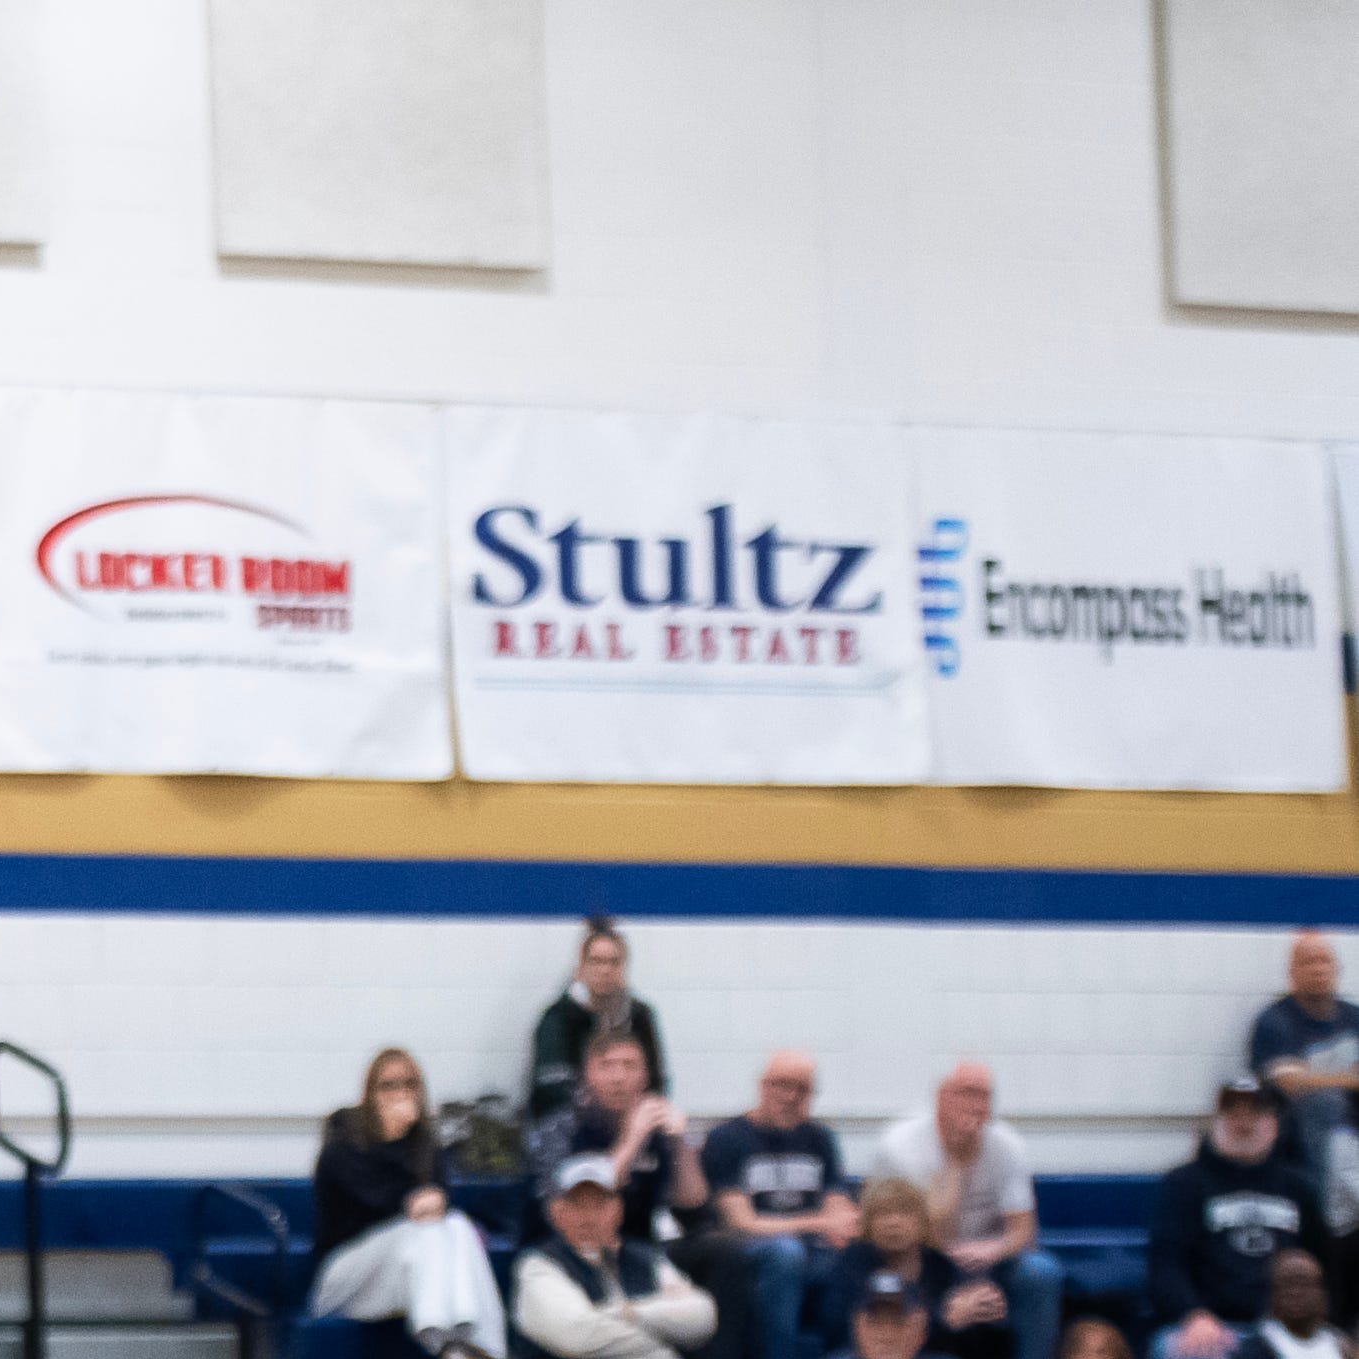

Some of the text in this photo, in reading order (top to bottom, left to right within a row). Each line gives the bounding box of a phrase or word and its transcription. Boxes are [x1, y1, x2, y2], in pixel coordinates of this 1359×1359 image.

[470, 504, 884, 614] Stultz
[984, 558, 1316, 667] Encompass Health
[491, 619, 863, 666] REAL ESTATE
